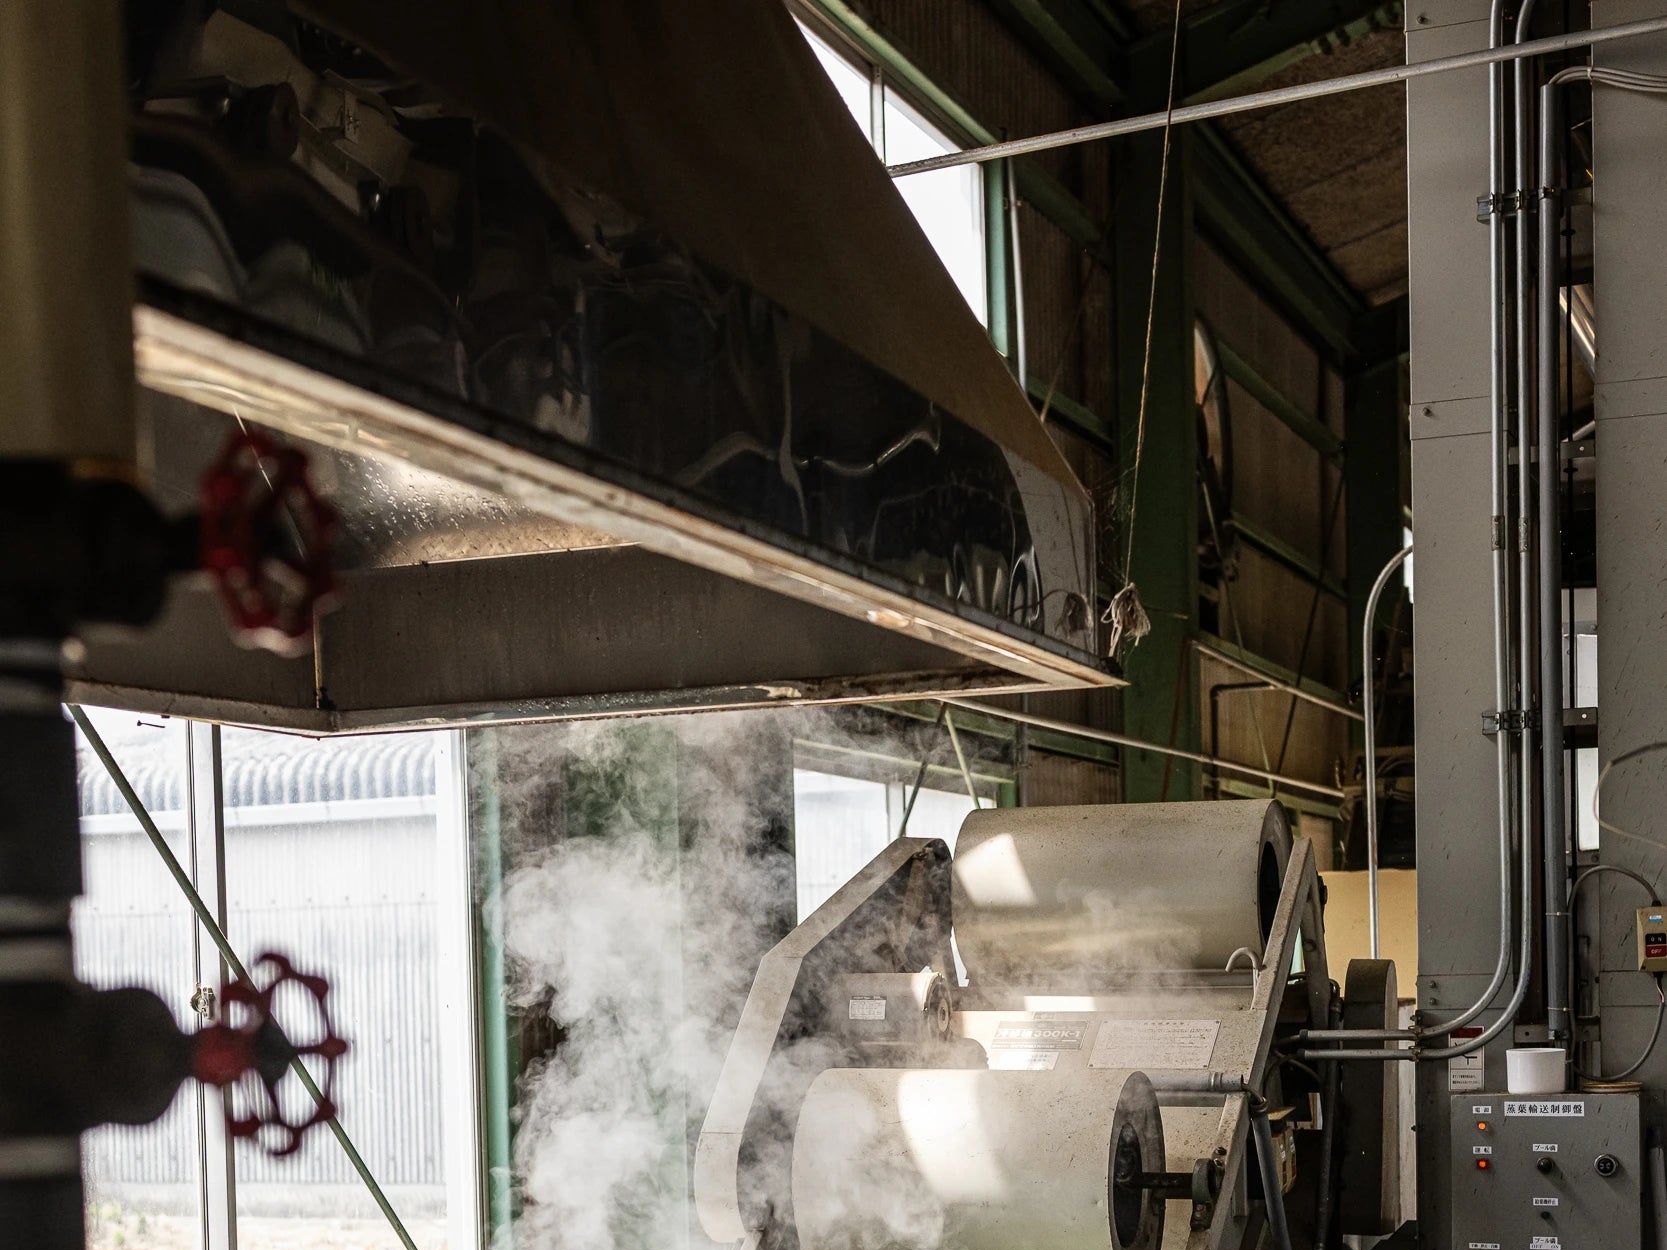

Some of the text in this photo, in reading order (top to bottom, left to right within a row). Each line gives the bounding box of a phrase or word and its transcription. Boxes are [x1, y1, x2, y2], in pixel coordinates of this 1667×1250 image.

[1506, 1103, 1583, 1115] 蒸葉輸送制御盤
